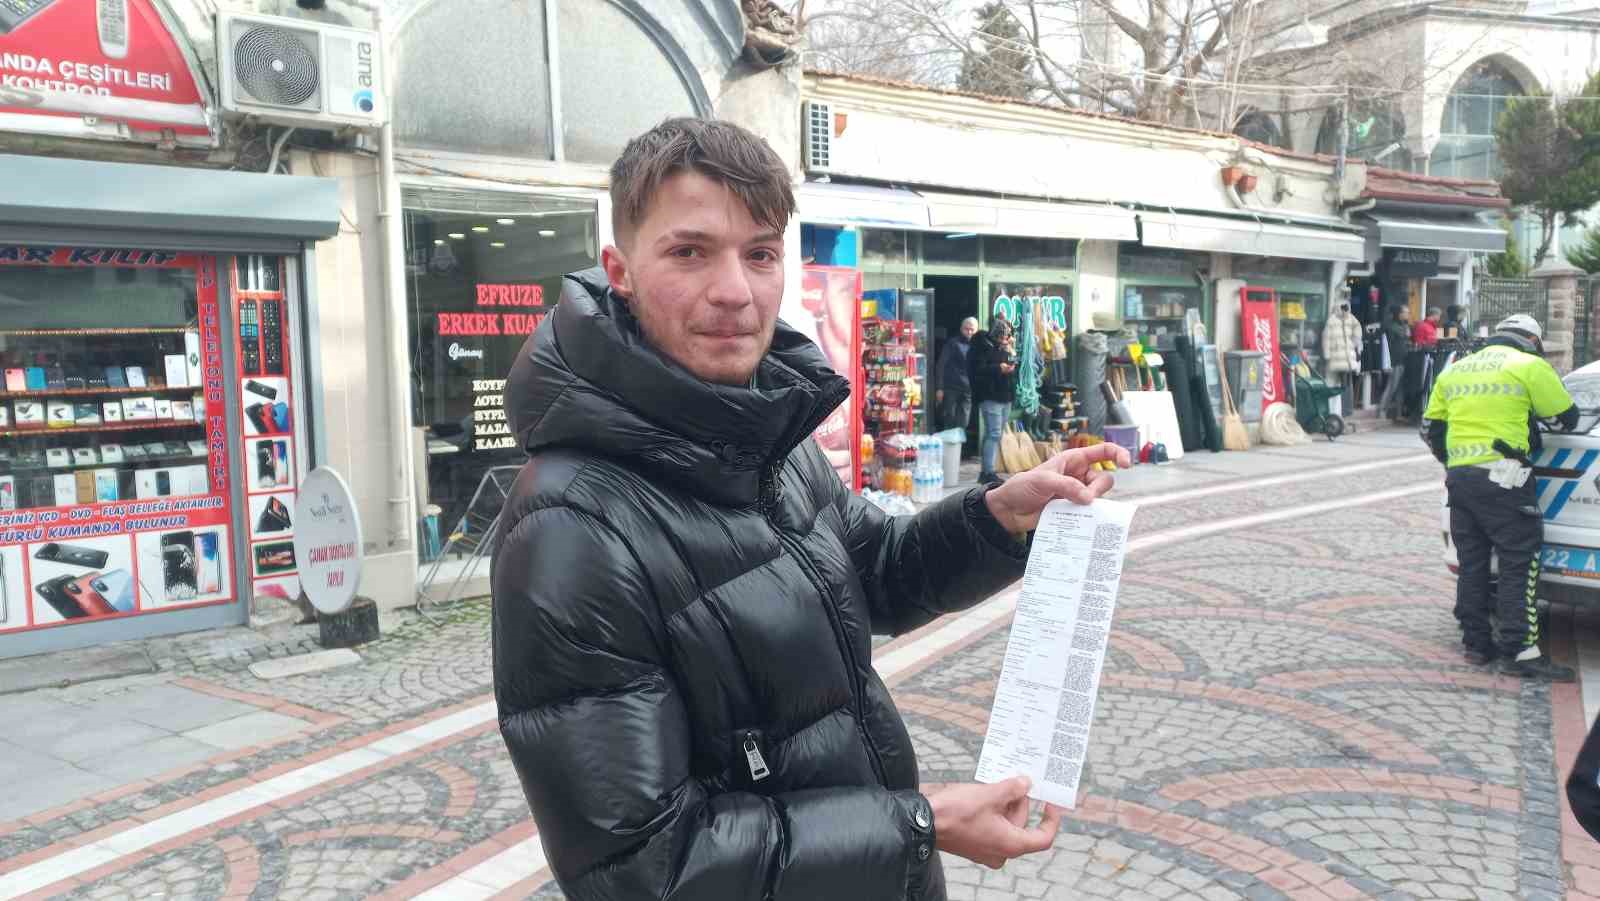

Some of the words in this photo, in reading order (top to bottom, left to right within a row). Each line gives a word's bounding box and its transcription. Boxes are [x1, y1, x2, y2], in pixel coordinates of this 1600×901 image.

[0, 52, 54, 75] NDA
[59, 60, 171, 91] ÇEŞİTLERİ
[358, 42, 373, 88] aura
[476, 285, 543, 306] EFRUZE
[438, 312, 500, 335] ERKEK
[70, 509, 92, 521] DVD
[48, 522, 121, 539] KUMANDA
[125, 516, 187, 531] BULUNUR
[1543, 550, 1569, 568] 22
[1584, 552, 1596, 571] A
